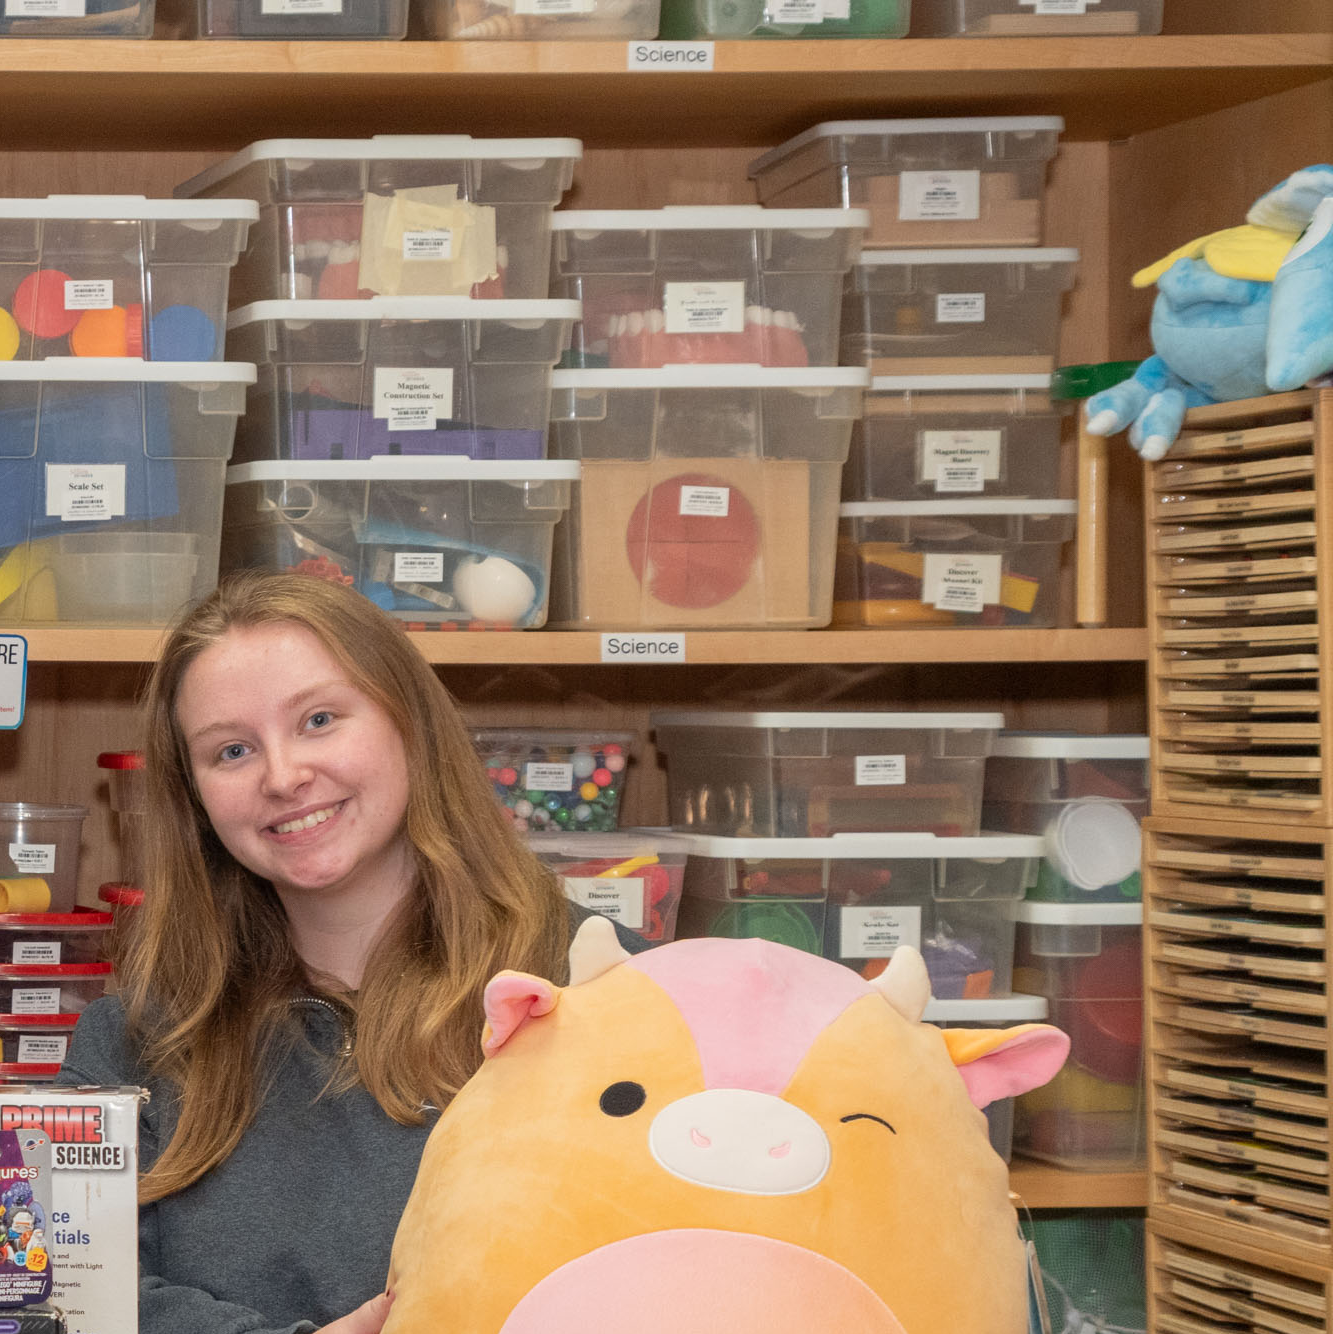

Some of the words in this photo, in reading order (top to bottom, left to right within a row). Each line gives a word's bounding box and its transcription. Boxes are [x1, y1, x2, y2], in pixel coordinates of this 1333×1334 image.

[635, 46, 707, 64] Science
[397, 382, 431, 392] Magnetic
[383, 392, 429, 400] Construction
[69, 482, 89, 490] Scale
[91, 482, 104, 490] Set
[607, 638, 679, 656] Science
[588, 892, 620, 900] Discover
[1, 1104, 103, 1144] PRIME
[57, 1147, 121, 1166] SCIENCE
